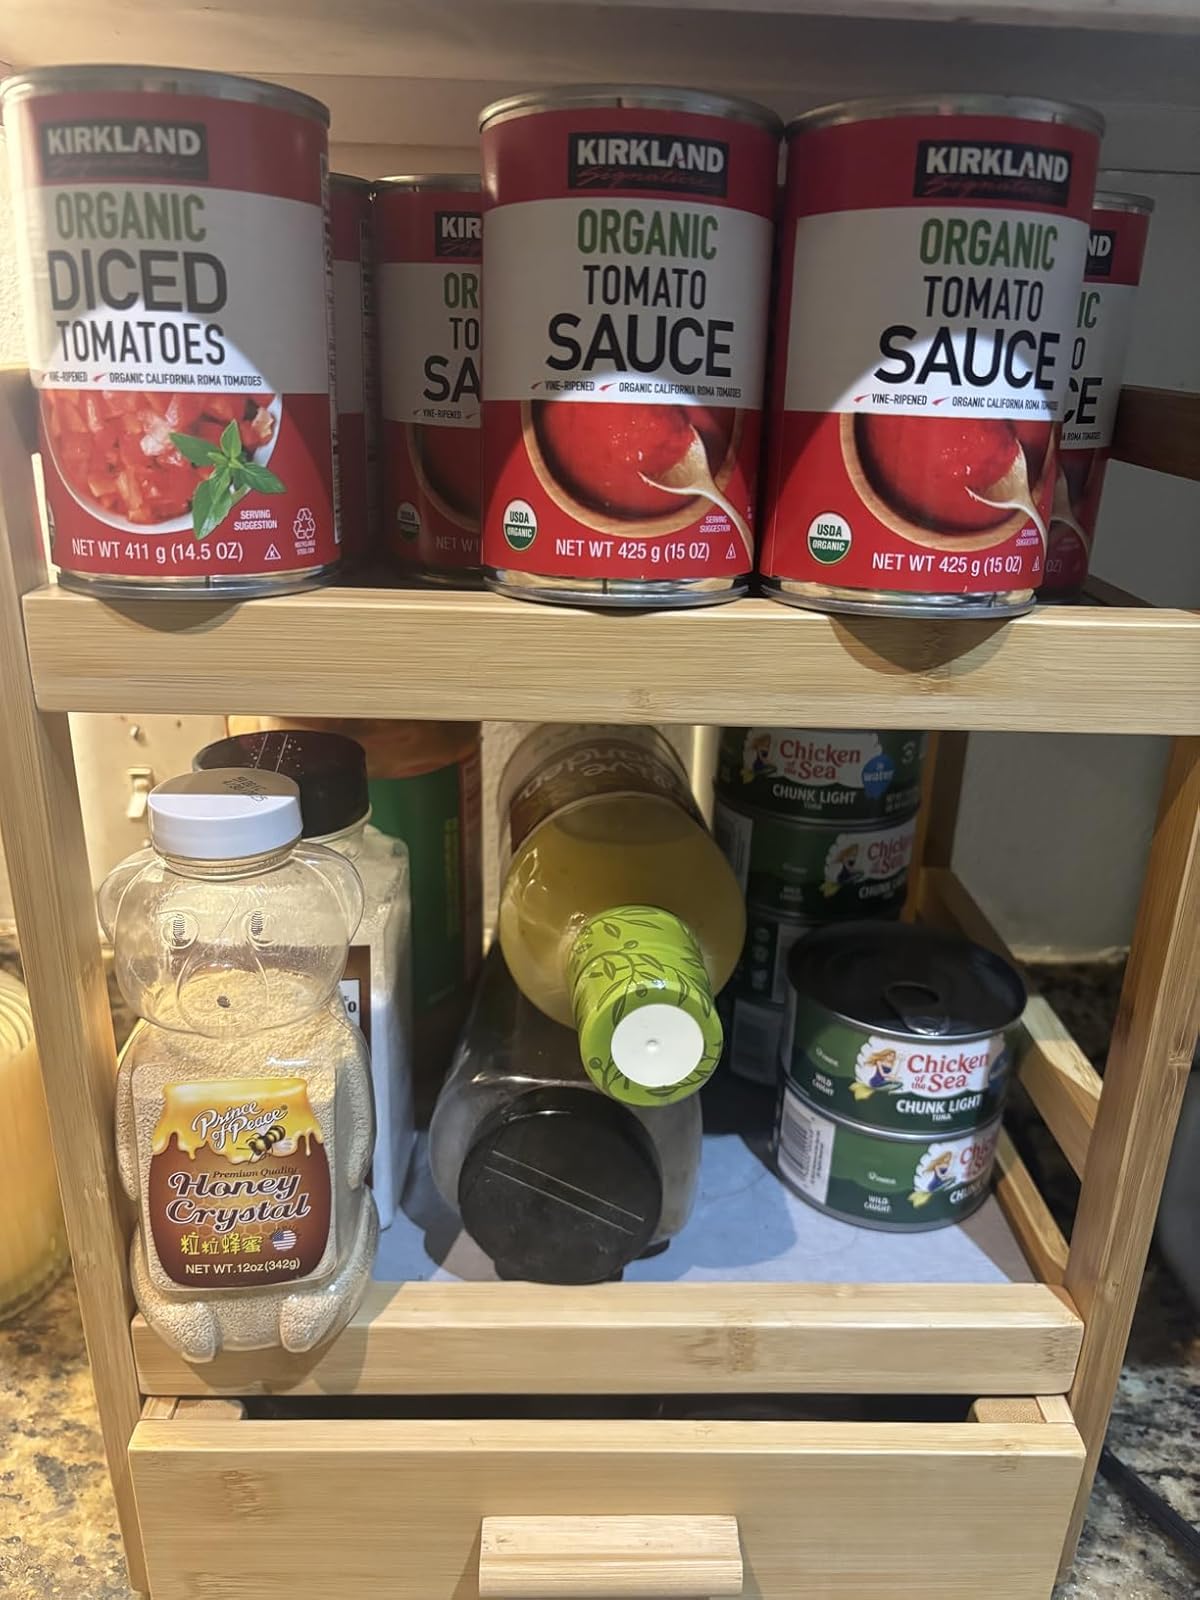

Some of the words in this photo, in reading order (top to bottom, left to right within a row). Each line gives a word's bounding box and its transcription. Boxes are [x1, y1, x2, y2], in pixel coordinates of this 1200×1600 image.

[48, 126, 200, 155] KIRKLAND
[577, 138, 725, 173] KIRKLAND
[926, 147, 1069, 183] KIRKLAND
[55, 191, 207, 242] ORGANIC
[578, 208, 719, 260] ORGANIC
[919, 218, 1058, 271] ORGANIC
[47, 248, 228, 314] DICED
[583, 264, 707, 310] TOMATO
[923, 276, 1044, 322] TOMATO
[57, 320, 226, 365] TOMATOES
[545, 313, 734, 378] SAUCE
[873, 325, 1061, 390] SAUCE
[109, 373, 144, 384] ORGANIC
[146, 374, 194, 385] CALIFORNIA
[197, 375, 221, 386] ROMA
[223, 375, 263, 387] TOMATOES
[544, 381, 595, 392] VINE-RIPENED
[619, 382, 652, 393] ORGANIC
[654, 383, 695, 395] CALIFORNIA
[872, 393, 928, 406] VINE-RIPENED
[952, 396, 985, 408] ORGANIC
[986, 397, 1024, 410] CALIFORNIA
[1024, 399, 1040, 411] ROMA
[233, 520, 278, 531] SUGGESTION
[240, 509, 271, 520] SERVING
[509, 511, 530, 524] USDA
[507, 526, 534, 538] ORGANIC
[816, 524, 843, 538] USDA
[72, 538, 95, 557] NET
[98, 540, 121, 558] WT
[125, 541, 149, 560] 411
[156, 546, 166, 564] g
[171, 543, 210, 563] (14.5
[216, 542, 244, 563] OZ)
[556, 539, 585, 556] NET
[588, 541, 613, 559] WT
[618, 542, 647, 560] 425
[651, 546, 660, 563] g
[664, 542, 685, 563] (15
[689, 542, 710, 561] OZ)
[812, 539, 846, 551] ORGANIC
[872, 552, 904, 569] NET
[909, 554, 935, 572] WT
[939, 556, 967, 573] 425
[971, 560, 980, 577] g
[984, 557, 1002, 576] (15
[1005, 556, 1023, 575] OZ)
[780, 740, 861, 768] Chicken
[797, 761, 837, 780] Sea
[772, 783, 816, 801] CHUNK
[819, 790, 857, 805] LIGHT
[907, 1053, 989, 1076] Chicken
[913, 1076, 924, 1084] of
[927, 1073, 968, 1092] Sea
[896, 1099, 946, 1115] CHUNK
[948, 1094, 983, 1112] LIGHT
[192, 1101, 264, 1139] Prince
[211, 1123, 230, 1150] of
[228, 1109, 288, 1143] Peace
[932, 1113, 952, 1122] TUNA
[213, 1170, 258, 1178] Premium
[260, 1166, 298, 1177] Quality
[168, 1171, 302, 1201] Honey
[166, 1193, 311, 1233] Crystal
[180, 1231, 263, 1256] 粒粒蜂蜜
[185, 1264, 210, 1275] NET
